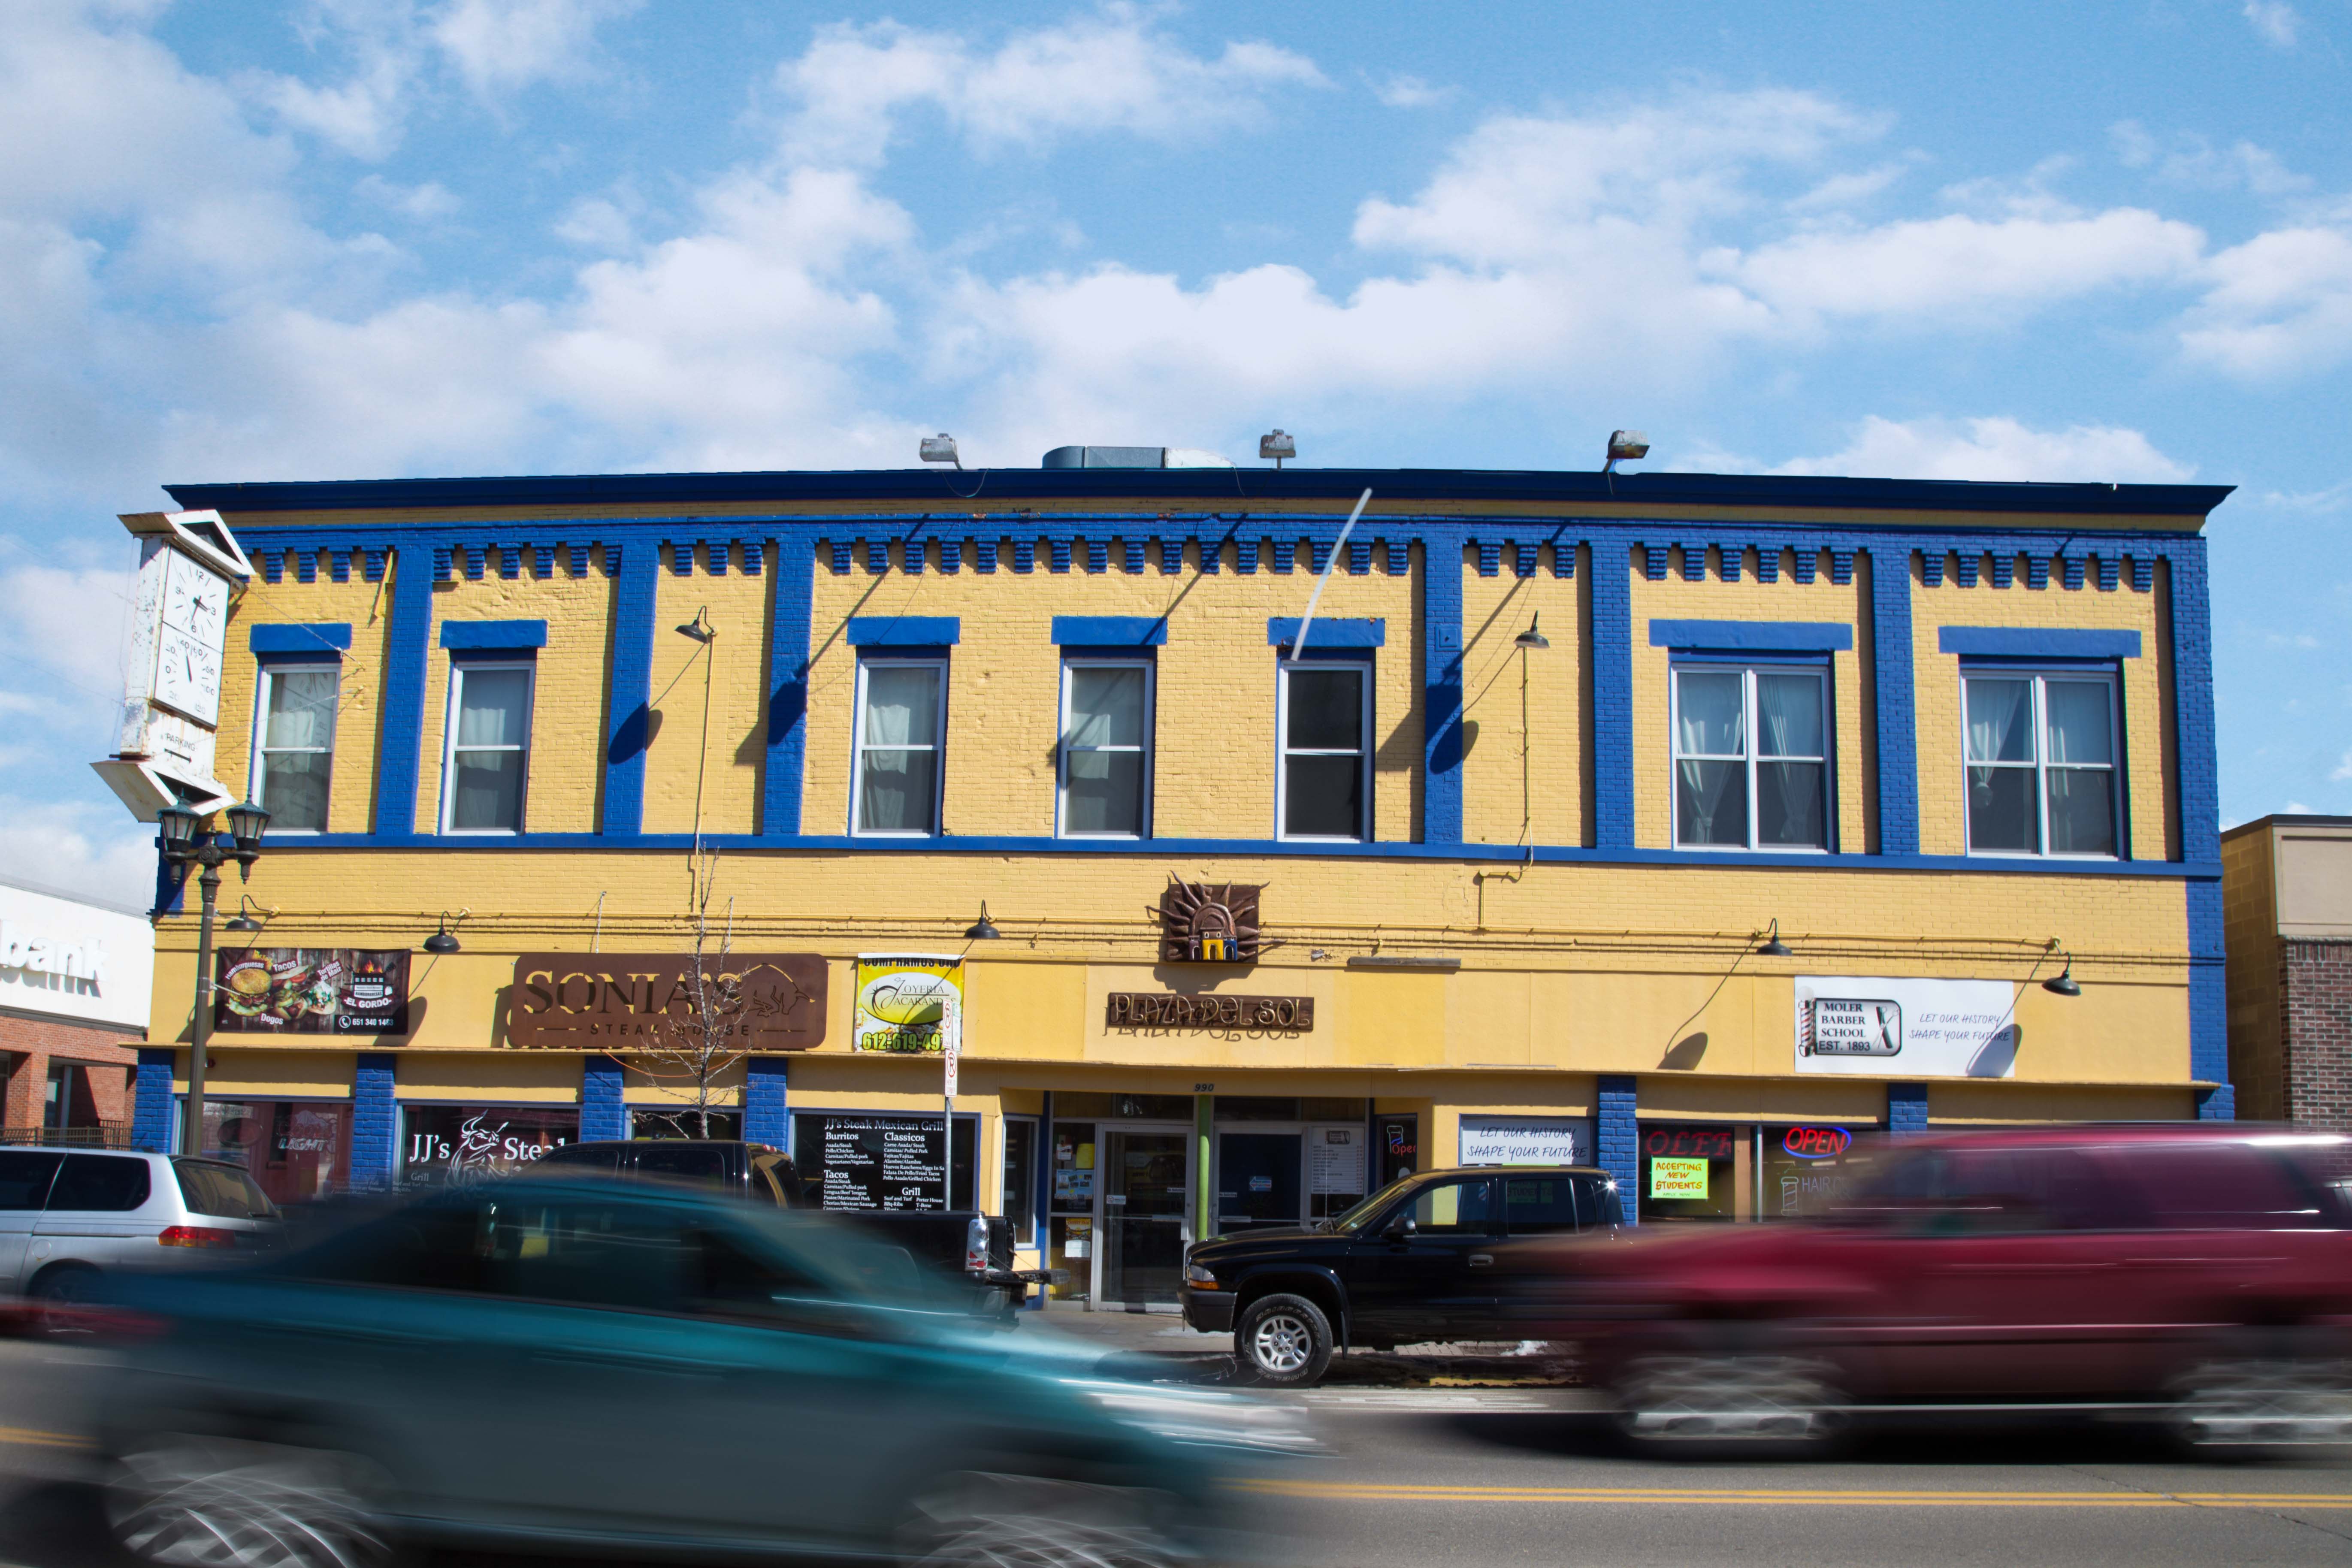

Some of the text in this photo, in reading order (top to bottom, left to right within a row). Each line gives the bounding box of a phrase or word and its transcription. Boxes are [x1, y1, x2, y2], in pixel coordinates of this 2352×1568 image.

[165, 733, 196, 751] PARKING
[0, 918, 109, 982] bank
[225, 961, 264, 980] Hamburguesas
[272, 961, 297, 972] Tacos
[317, 961, 340, 976] Tortillas
[524, 971, 742, 1015] SONIA'S
[1115, 994, 1194, 1024] PLAZA
[1258, 998, 1310, 1027] SOL
[1824, 1003, 1863, 1012] MOLER
[261, 1013, 284, 1024] Dogos
[1821, 1015, 1866, 1024] BARBER
[1919, 1013, 2001, 1028] LET OUR HISTORY
[590, 1024, 749, 1036] STEAK HOSE
[1821, 1027, 1866, 1037] SCHOOL
[1908, 1030, 2011, 1044] SHAPE YOUR FUTURE
[1819, 1040, 1871, 1051] EST. 1893
[1195, 1084, 1215, 1093] 990
[825, 1118, 943, 1131] JJ's Steak Mexican Grill
[825, 1132, 859, 1140] Burritos
[884, 1132, 925, 1142] Classicos
[1480, 1126, 1577, 1142] LET OUR HISTORY
[278, 1138, 328, 1151] LIGHT
[1785, 1127, 1847, 1155] OPEN
[409, 1134, 450, 1163] JJ's
[1467, 1145, 1588, 1161] SHAPE YOUR FUTURE
[1655, 1162, 1702, 1171] ACCEPTING
[824, 1169, 849, 1178] Tacos
[1655, 1180, 1703, 1190] STUDENTS
[902, 1187, 921, 1196] Grill
